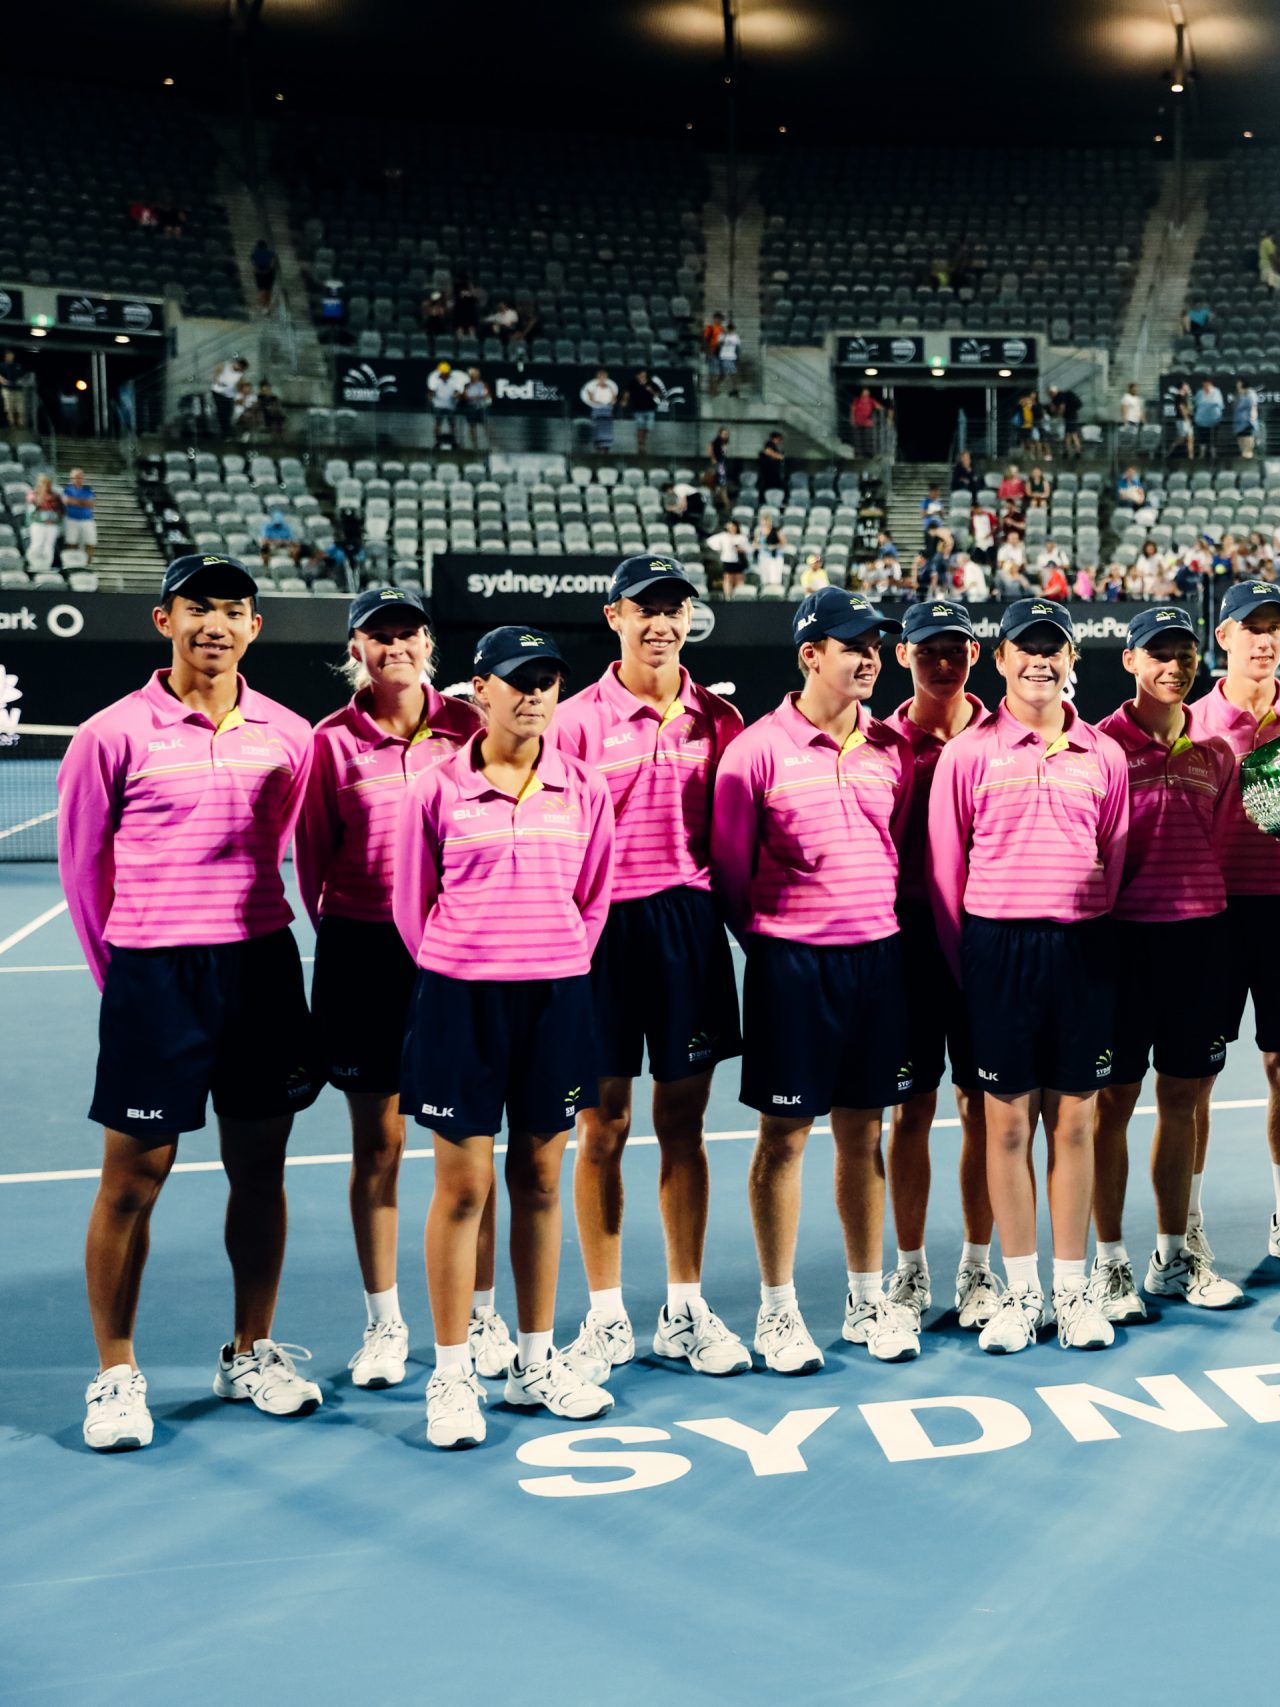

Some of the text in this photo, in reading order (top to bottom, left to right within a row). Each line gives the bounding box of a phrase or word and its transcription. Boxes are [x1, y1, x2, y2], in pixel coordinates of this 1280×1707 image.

[496, 378, 560, 400] FedEx
[467, 569, 612, 598] sydney.com
[148, 738, 185, 752] BLK
[603, 732, 636, 748] BLK
[784, 755, 814, 767] BLK
[990, 755, 1017, 768] BLK
[1127, 758, 1148, 769] LK
[453, 807, 489, 821] BLK
[978, 1067, 999, 1082] BLK
[772, 1094, 802, 1105] BLK
[127, 1108, 164, 1120] BLK
[421, 1103, 455, 1118] BLK
